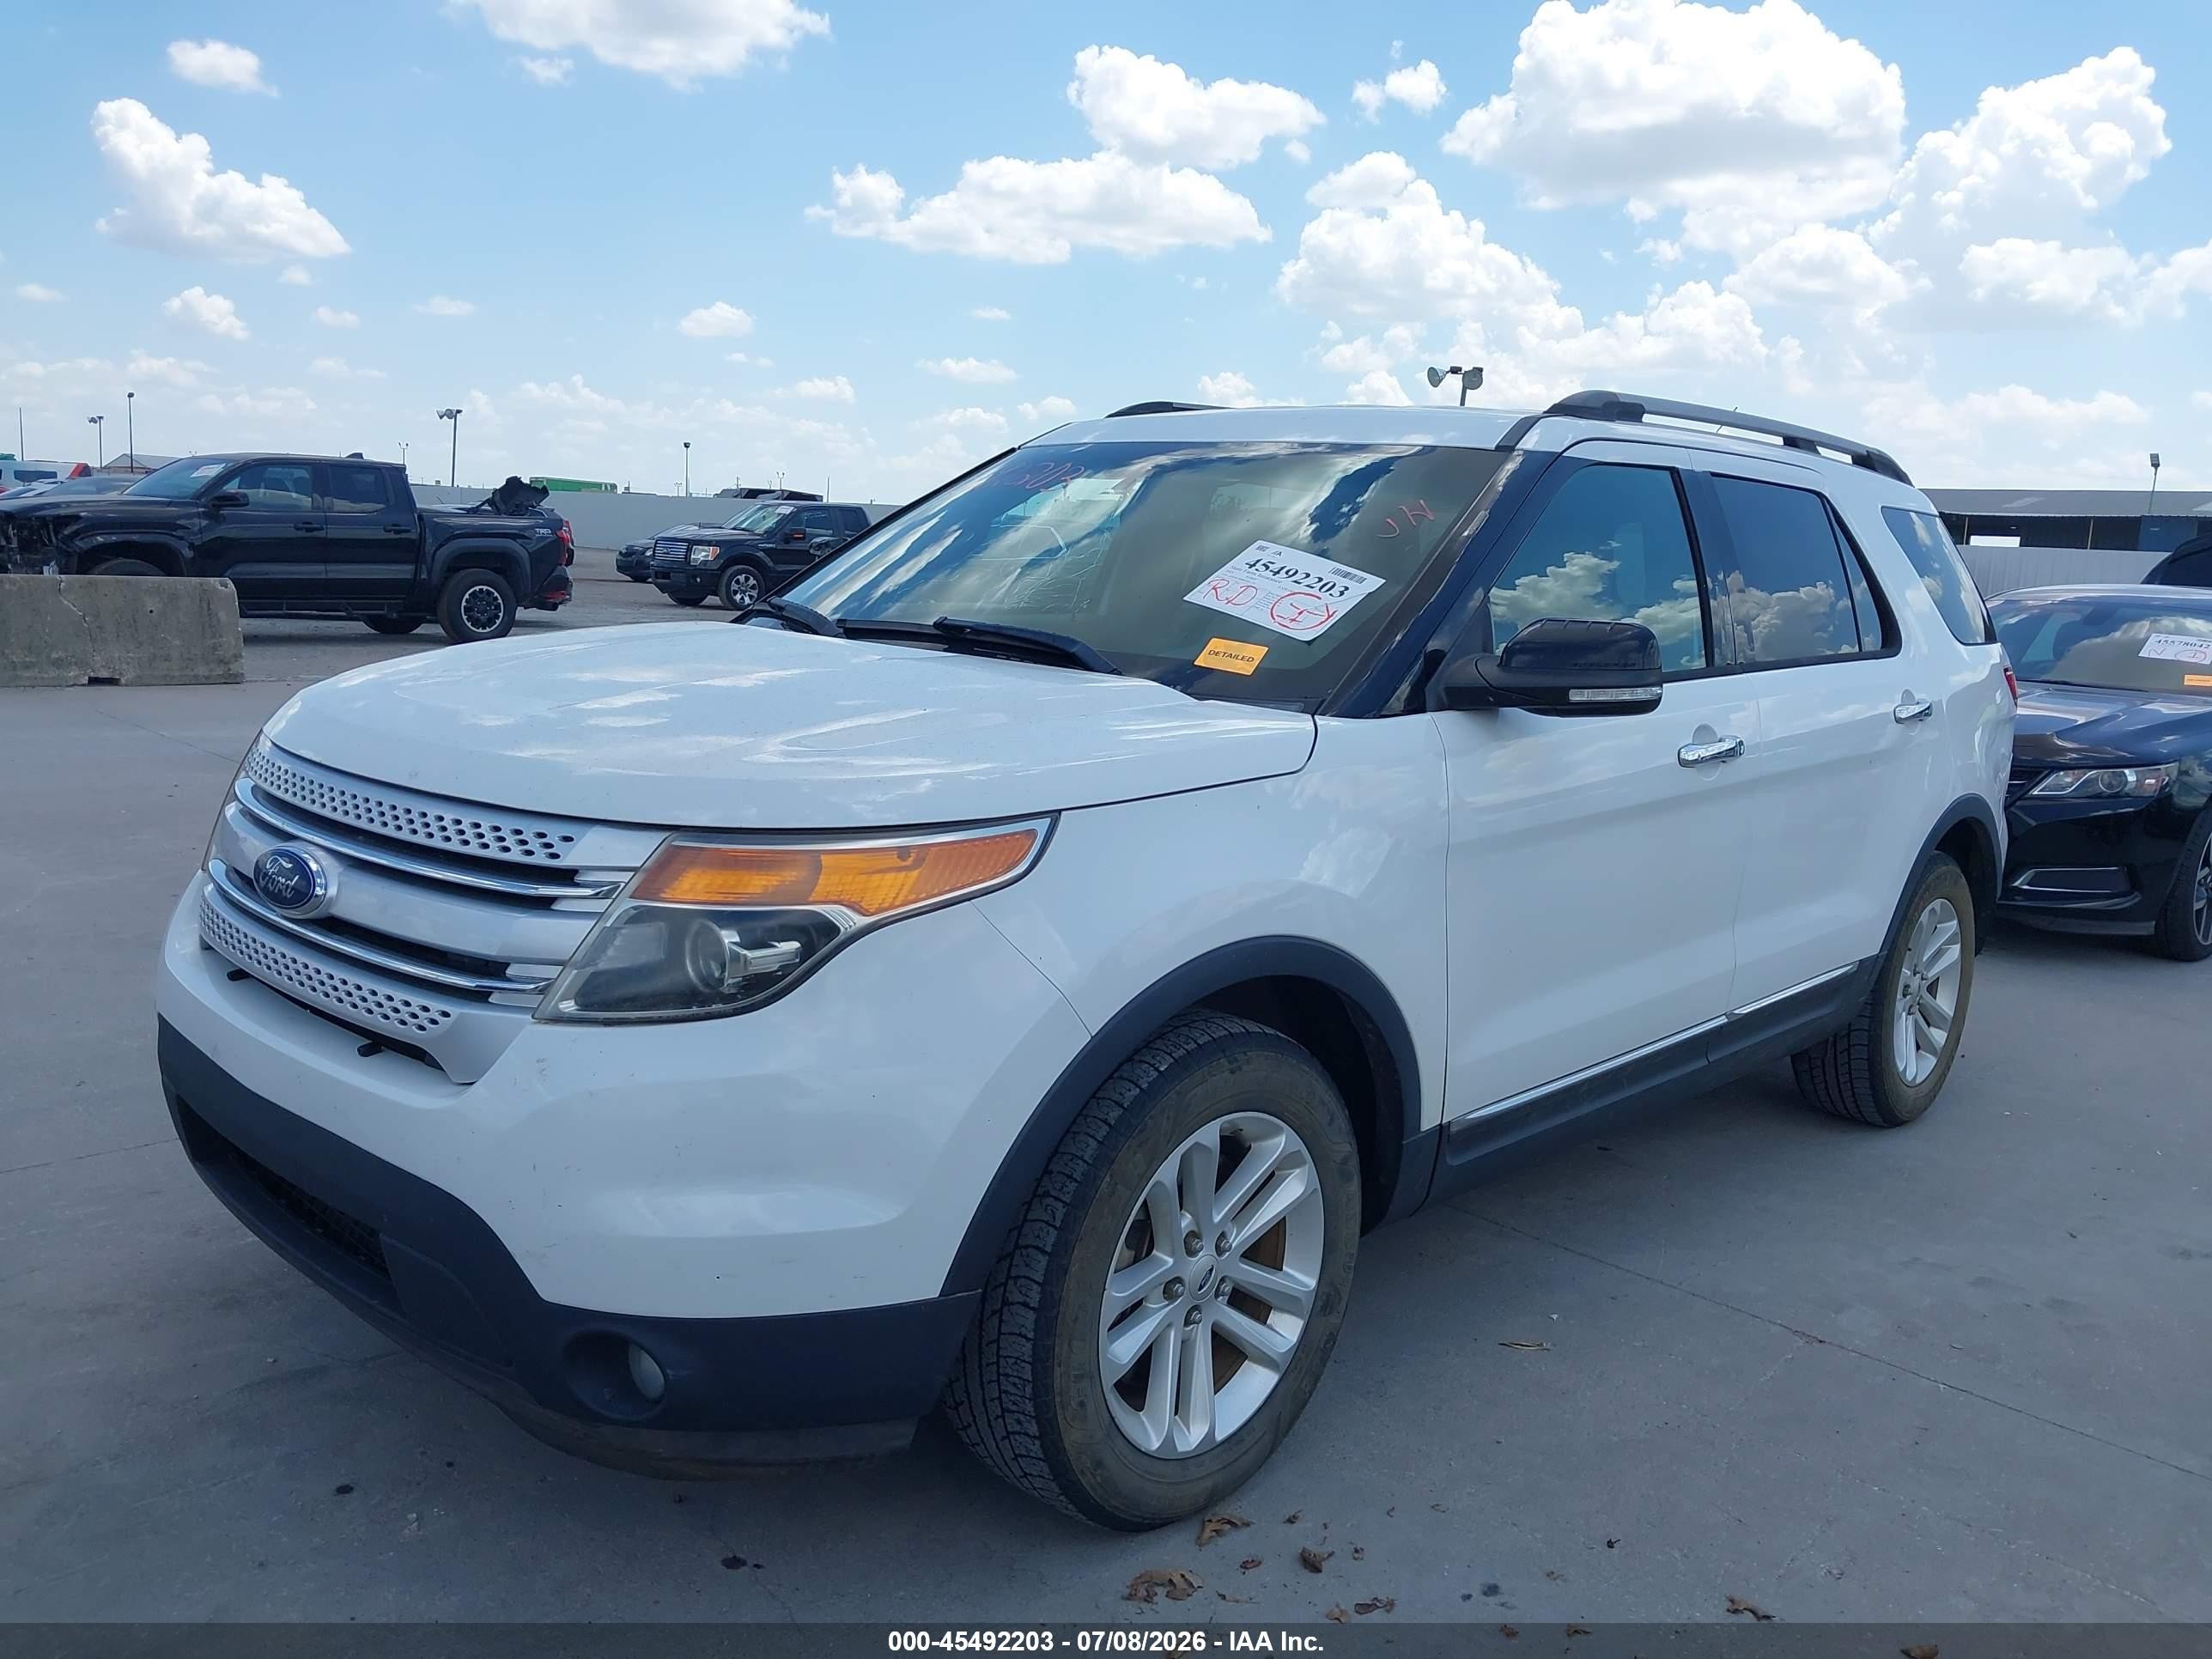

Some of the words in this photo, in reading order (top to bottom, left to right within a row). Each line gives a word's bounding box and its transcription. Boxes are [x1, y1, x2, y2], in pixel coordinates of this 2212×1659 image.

[1202, 579, 1258, 606] RD
[1244, 557, 1351, 599] 45492203
[1207, 649, 1255, 663] DETAILED
[258, 854, 301, 899] Ford
